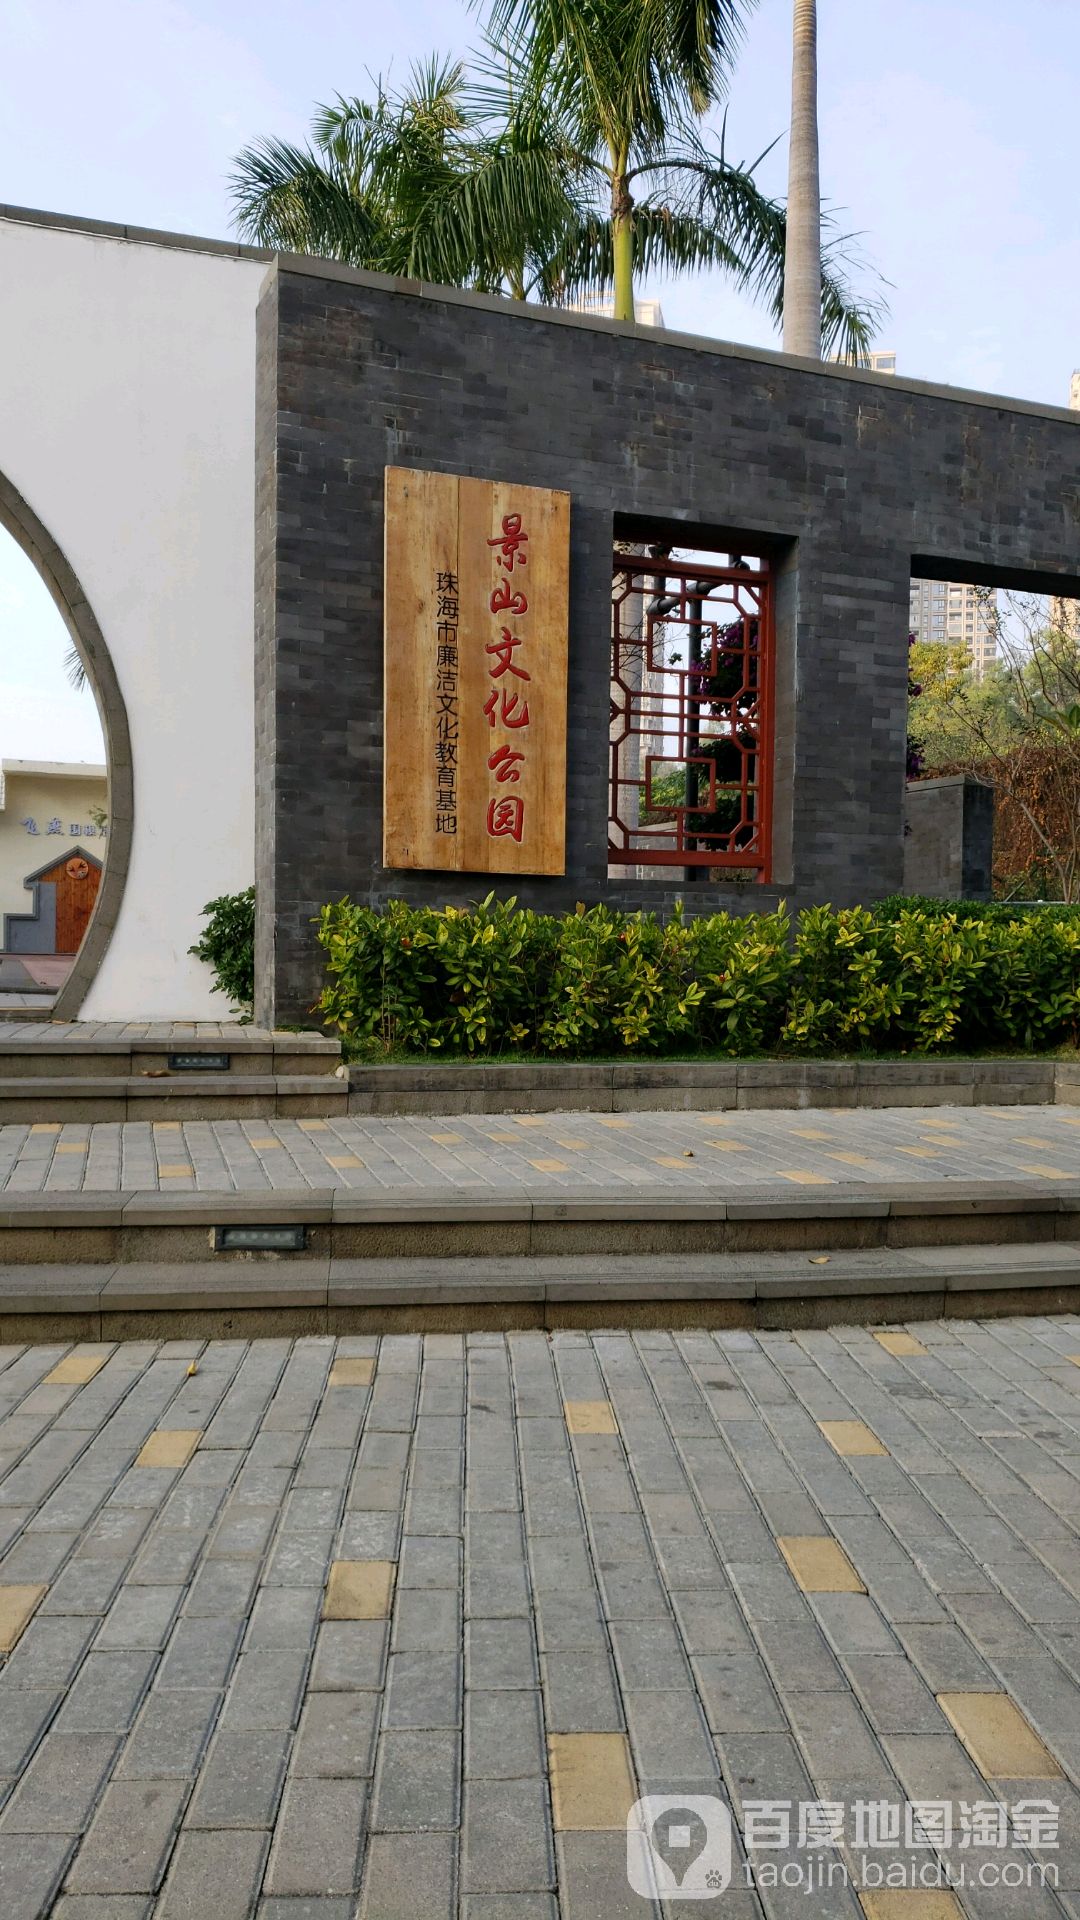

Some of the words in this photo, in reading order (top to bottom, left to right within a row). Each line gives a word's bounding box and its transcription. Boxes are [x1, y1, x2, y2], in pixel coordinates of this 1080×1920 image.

[435, 571, 459, 835] 珠海市廉洁文化教育基地
[483, 512, 532, 843] 景山文化公园
